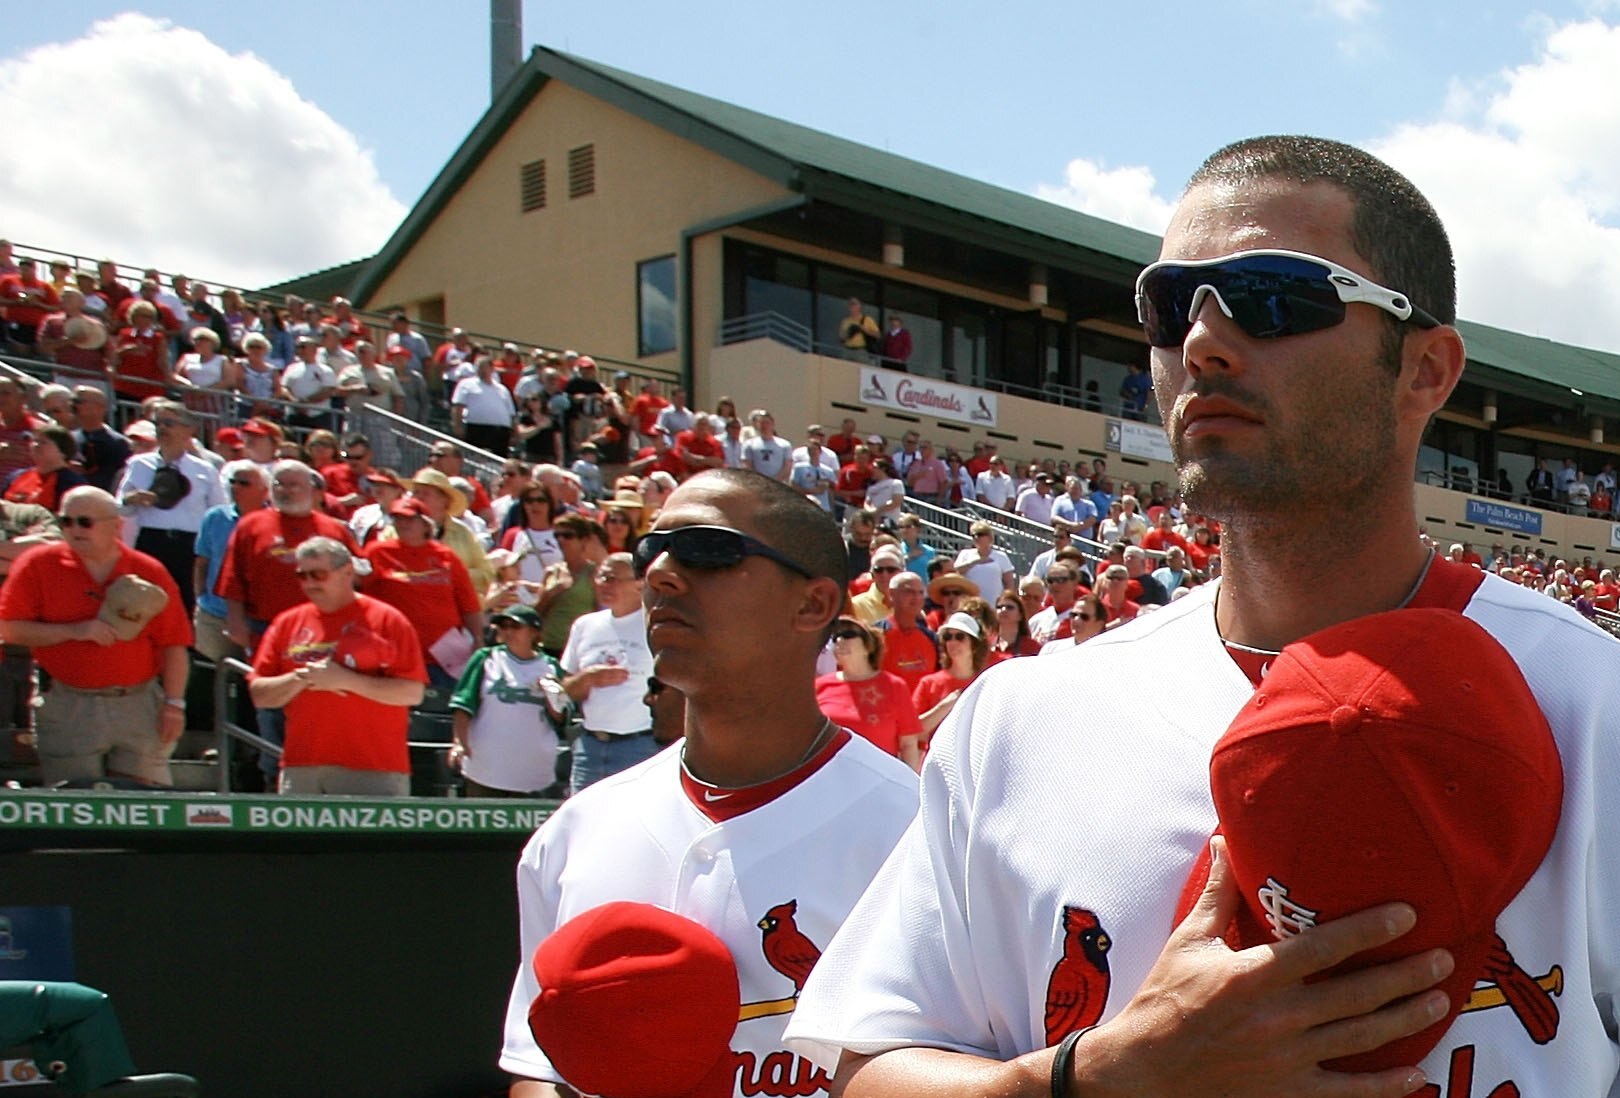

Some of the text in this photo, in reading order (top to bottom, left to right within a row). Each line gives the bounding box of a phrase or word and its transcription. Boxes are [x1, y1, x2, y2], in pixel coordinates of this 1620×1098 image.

[896, 379, 962, 413] Cardinals
[1471, 501, 1486, 513] The
[1504, 508, 1525, 522] Beach
[1525, 512, 1538, 524] Post
[250, 807, 554, 829] BONANZASPORTS.NE
